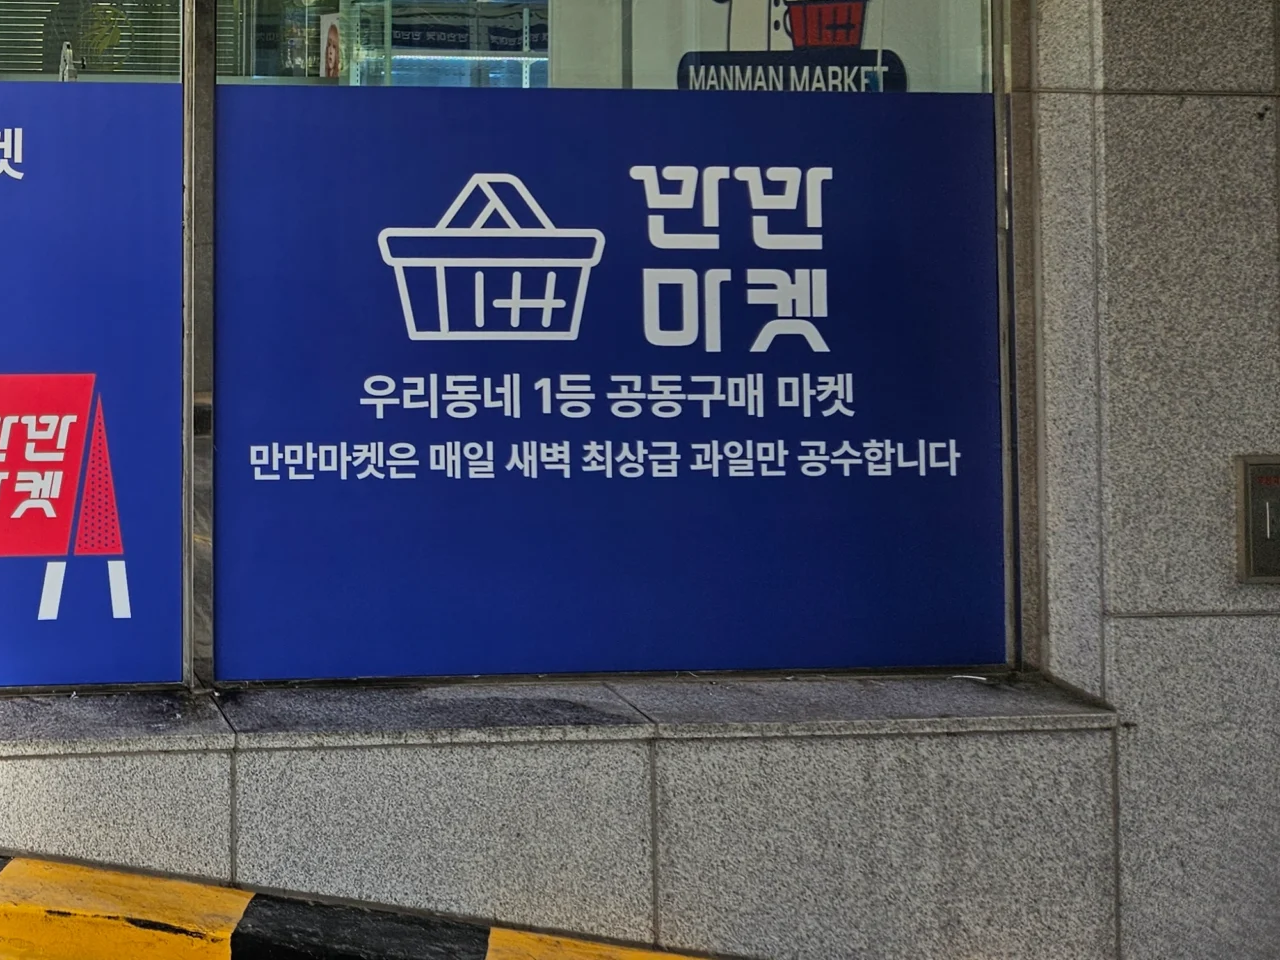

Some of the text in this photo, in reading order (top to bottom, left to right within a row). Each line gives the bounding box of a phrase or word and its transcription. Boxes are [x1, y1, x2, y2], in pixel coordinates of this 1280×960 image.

[688, 64, 784, 91] MANMAN
[630, 166, 832, 249] 만만
[644, 269, 830, 352] 마켓
[360, 374, 854, 418] 우리동네 1등 공동구매 마켓
[251, 440, 960, 480] 만만마켓은 매일 새벽 최상급 과일만 공수합니다
